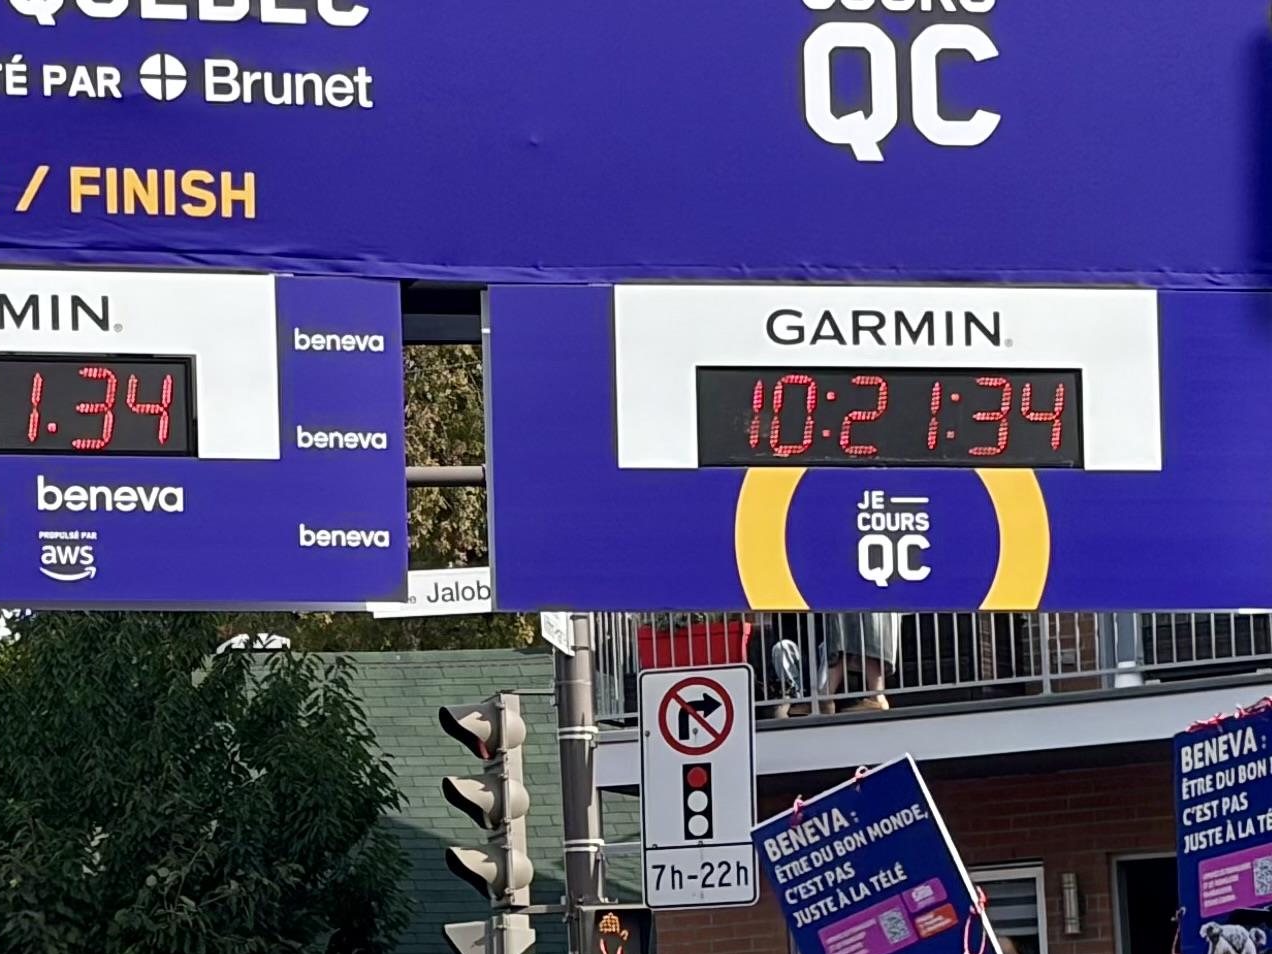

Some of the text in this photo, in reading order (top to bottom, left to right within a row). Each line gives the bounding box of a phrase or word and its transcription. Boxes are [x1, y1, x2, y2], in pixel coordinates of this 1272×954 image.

[42, 64, 123, 99] PAR
[204, 58, 374, 108] Brunet
[803, 21, 1002, 162] QC
[70, 167, 257, 219] FINISH
[293, 329, 384, 354] beneva
[766, 309, 1003, 348] GARMIN
[749, 374, 1065, 457] 10:21:34
[296, 426, 387, 451] beneva
[37, 475, 184, 512] beneva
[858, 490, 885, 511] JE
[80, 531, 98, 540] PAR
[299, 524, 391, 548] beneva
[857, 512, 930, 532] COURS
[40, 545, 95, 565] aws
[857, 535, 932, 588] QC
[1180, 726, 1257, 774] BENEVA
[1181, 775, 1215, 800] ÊTRE
[1216, 767, 1235, 790] DU
[1238, 761, 1268, 784] BON
[1182, 792, 1249, 826] C'EST PAS
[763, 807, 850, 863] BENEVA
[1184, 825, 1224, 854] JUSTE
[1238, 817, 1256, 839] LA
[775, 856, 813, 885] ÊTRE
[812, 848, 835, 874] DU
[834, 833, 868, 858] BON
[784, 861, 856, 906] C'EST PAS
[793, 897, 838, 929] JUSTE
[850, 882, 872, 903] LA
[869, 861, 908, 892] TÉLÉ
